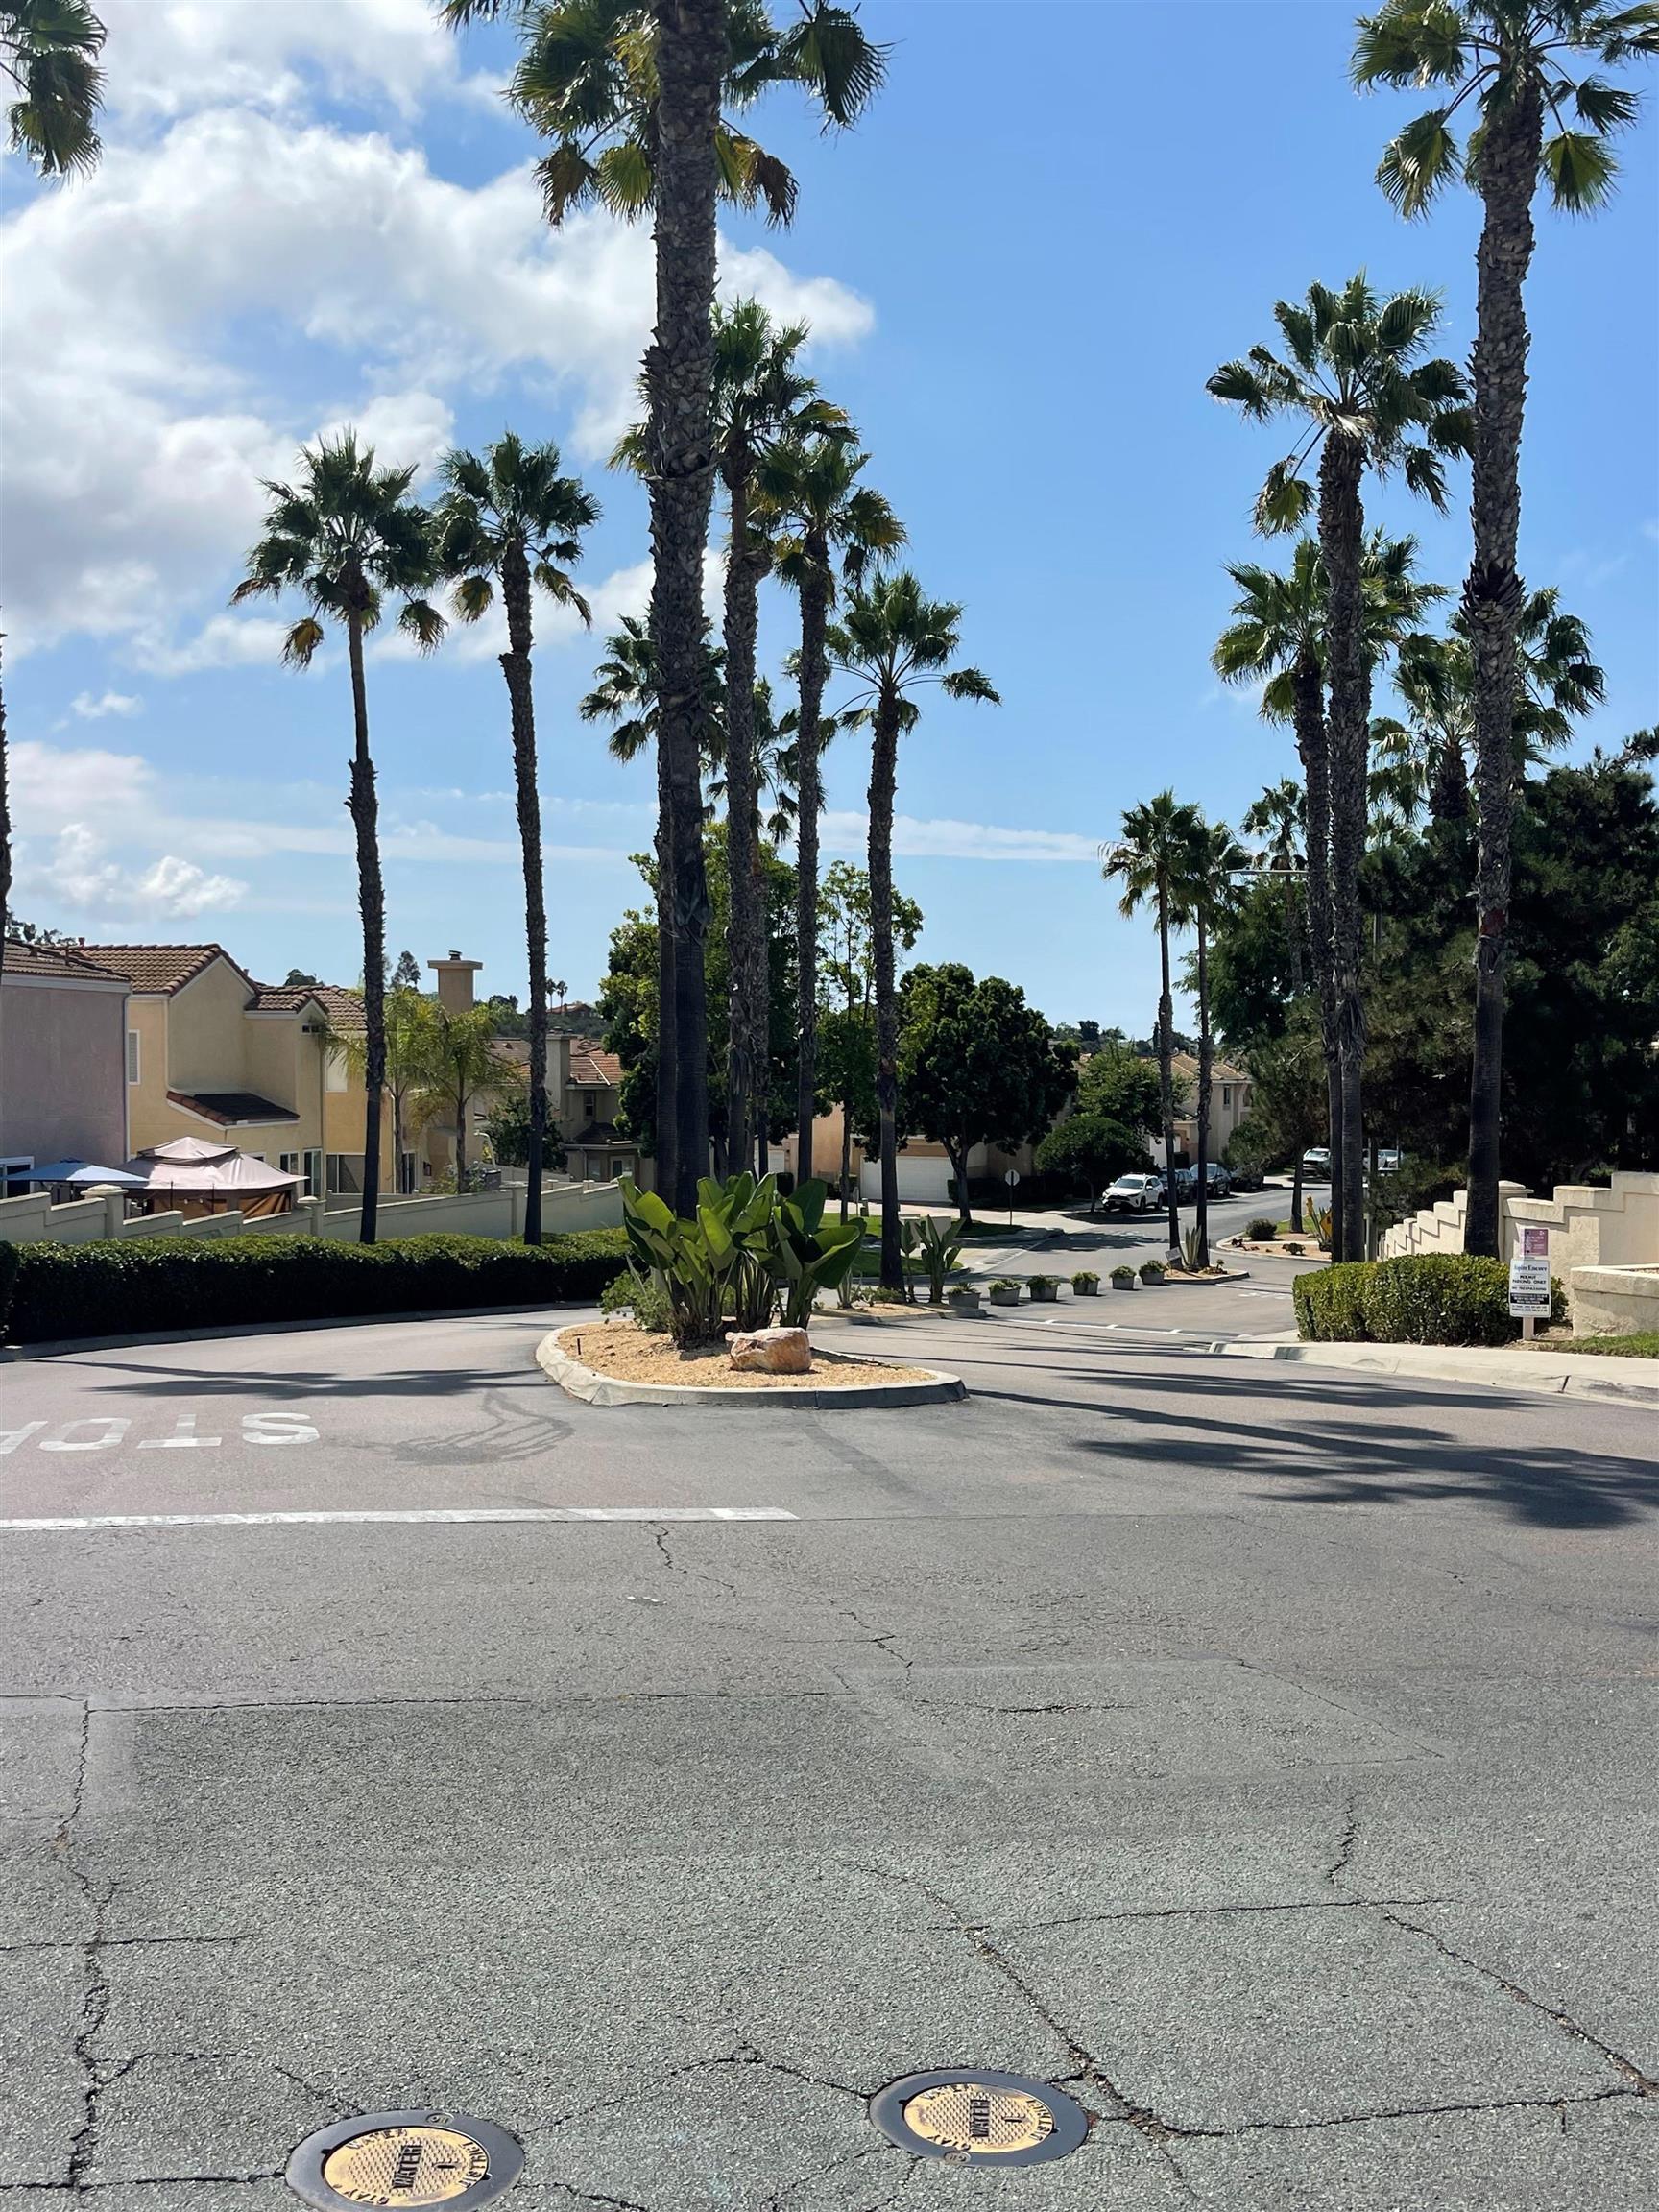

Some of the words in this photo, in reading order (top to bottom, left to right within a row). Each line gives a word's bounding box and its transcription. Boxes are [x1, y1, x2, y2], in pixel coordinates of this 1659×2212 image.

[970, 2099, 991, 2138] WATER
[1025, 2100, 1053, 2142] DISTRICT
[346, 2128, 408, 2150] WATER
[927, 2134, 972, 2151] OTAY
[392, 2144, 423, 2189] WATER
[458, 2141, 488, 2190] DISTRICT
[343, 2189, 390, 2206] OTAY
